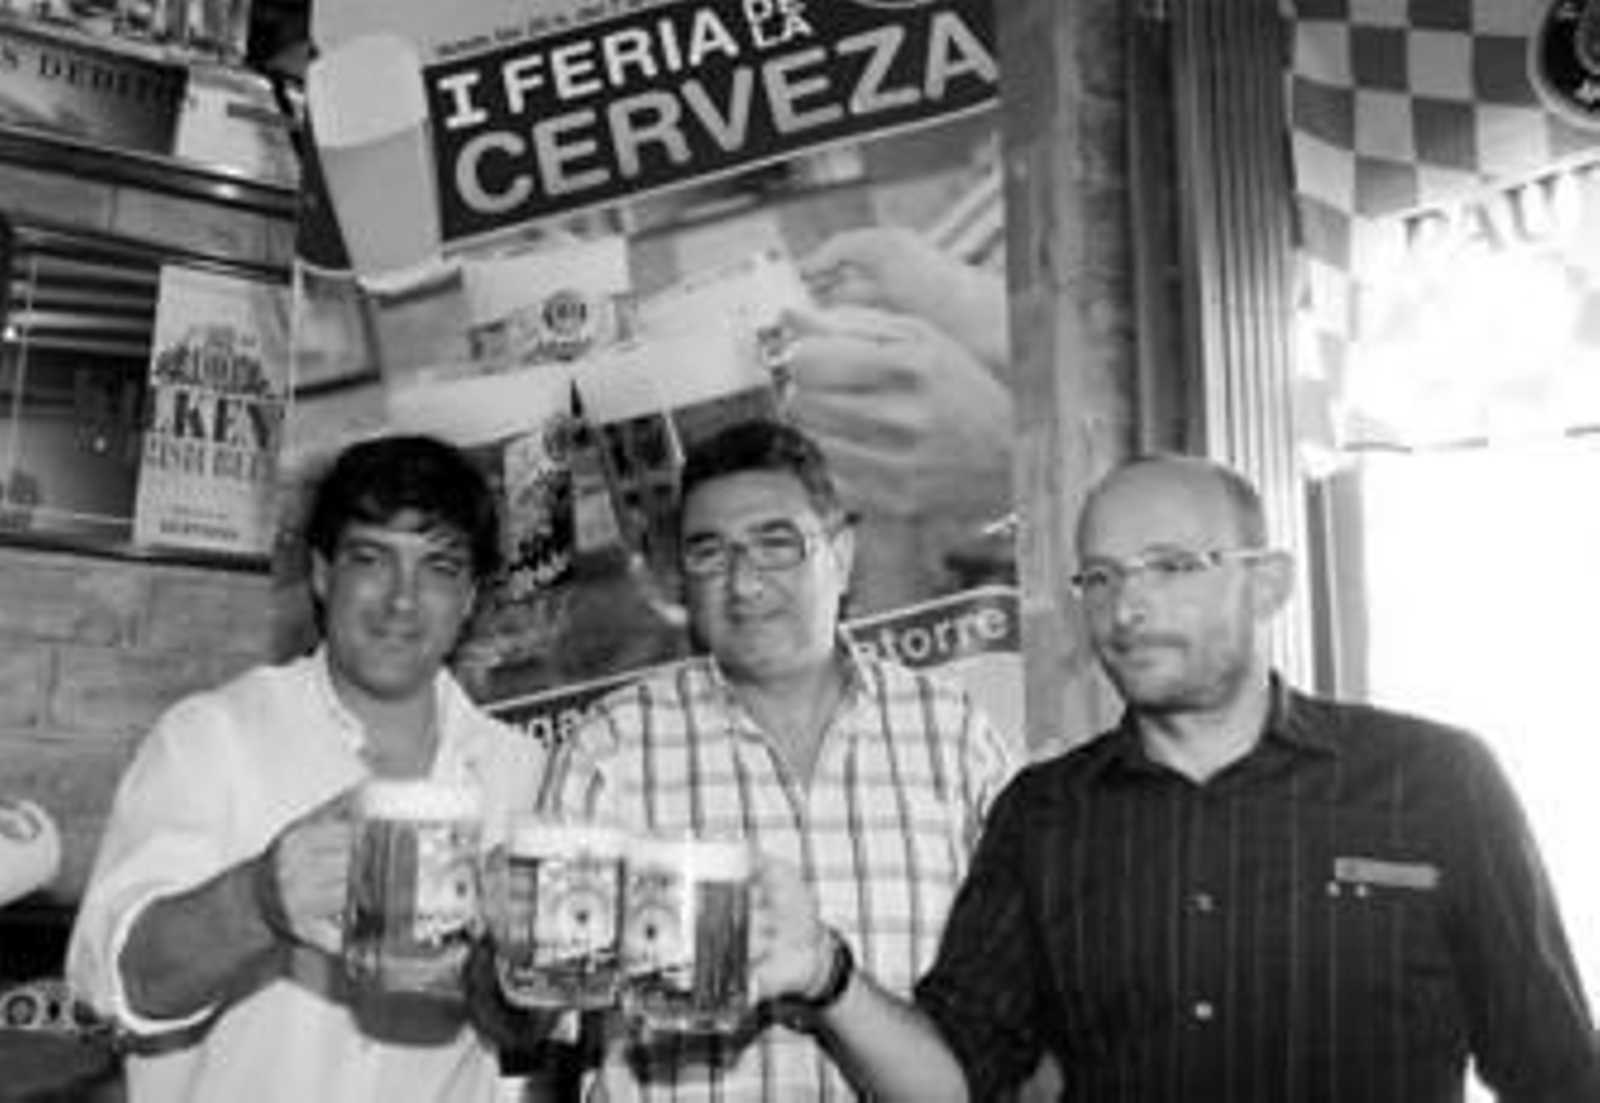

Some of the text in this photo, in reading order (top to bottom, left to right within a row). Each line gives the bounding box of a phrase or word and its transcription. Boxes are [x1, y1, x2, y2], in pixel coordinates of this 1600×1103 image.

[437, 71, 489, 129] I
[502, 7, 740, 115] FERIA
[751, 15, 815, 49] LA
[454, 9, 998, 214] CERVEZA
[1402, 160, 1600, 252] PAU
